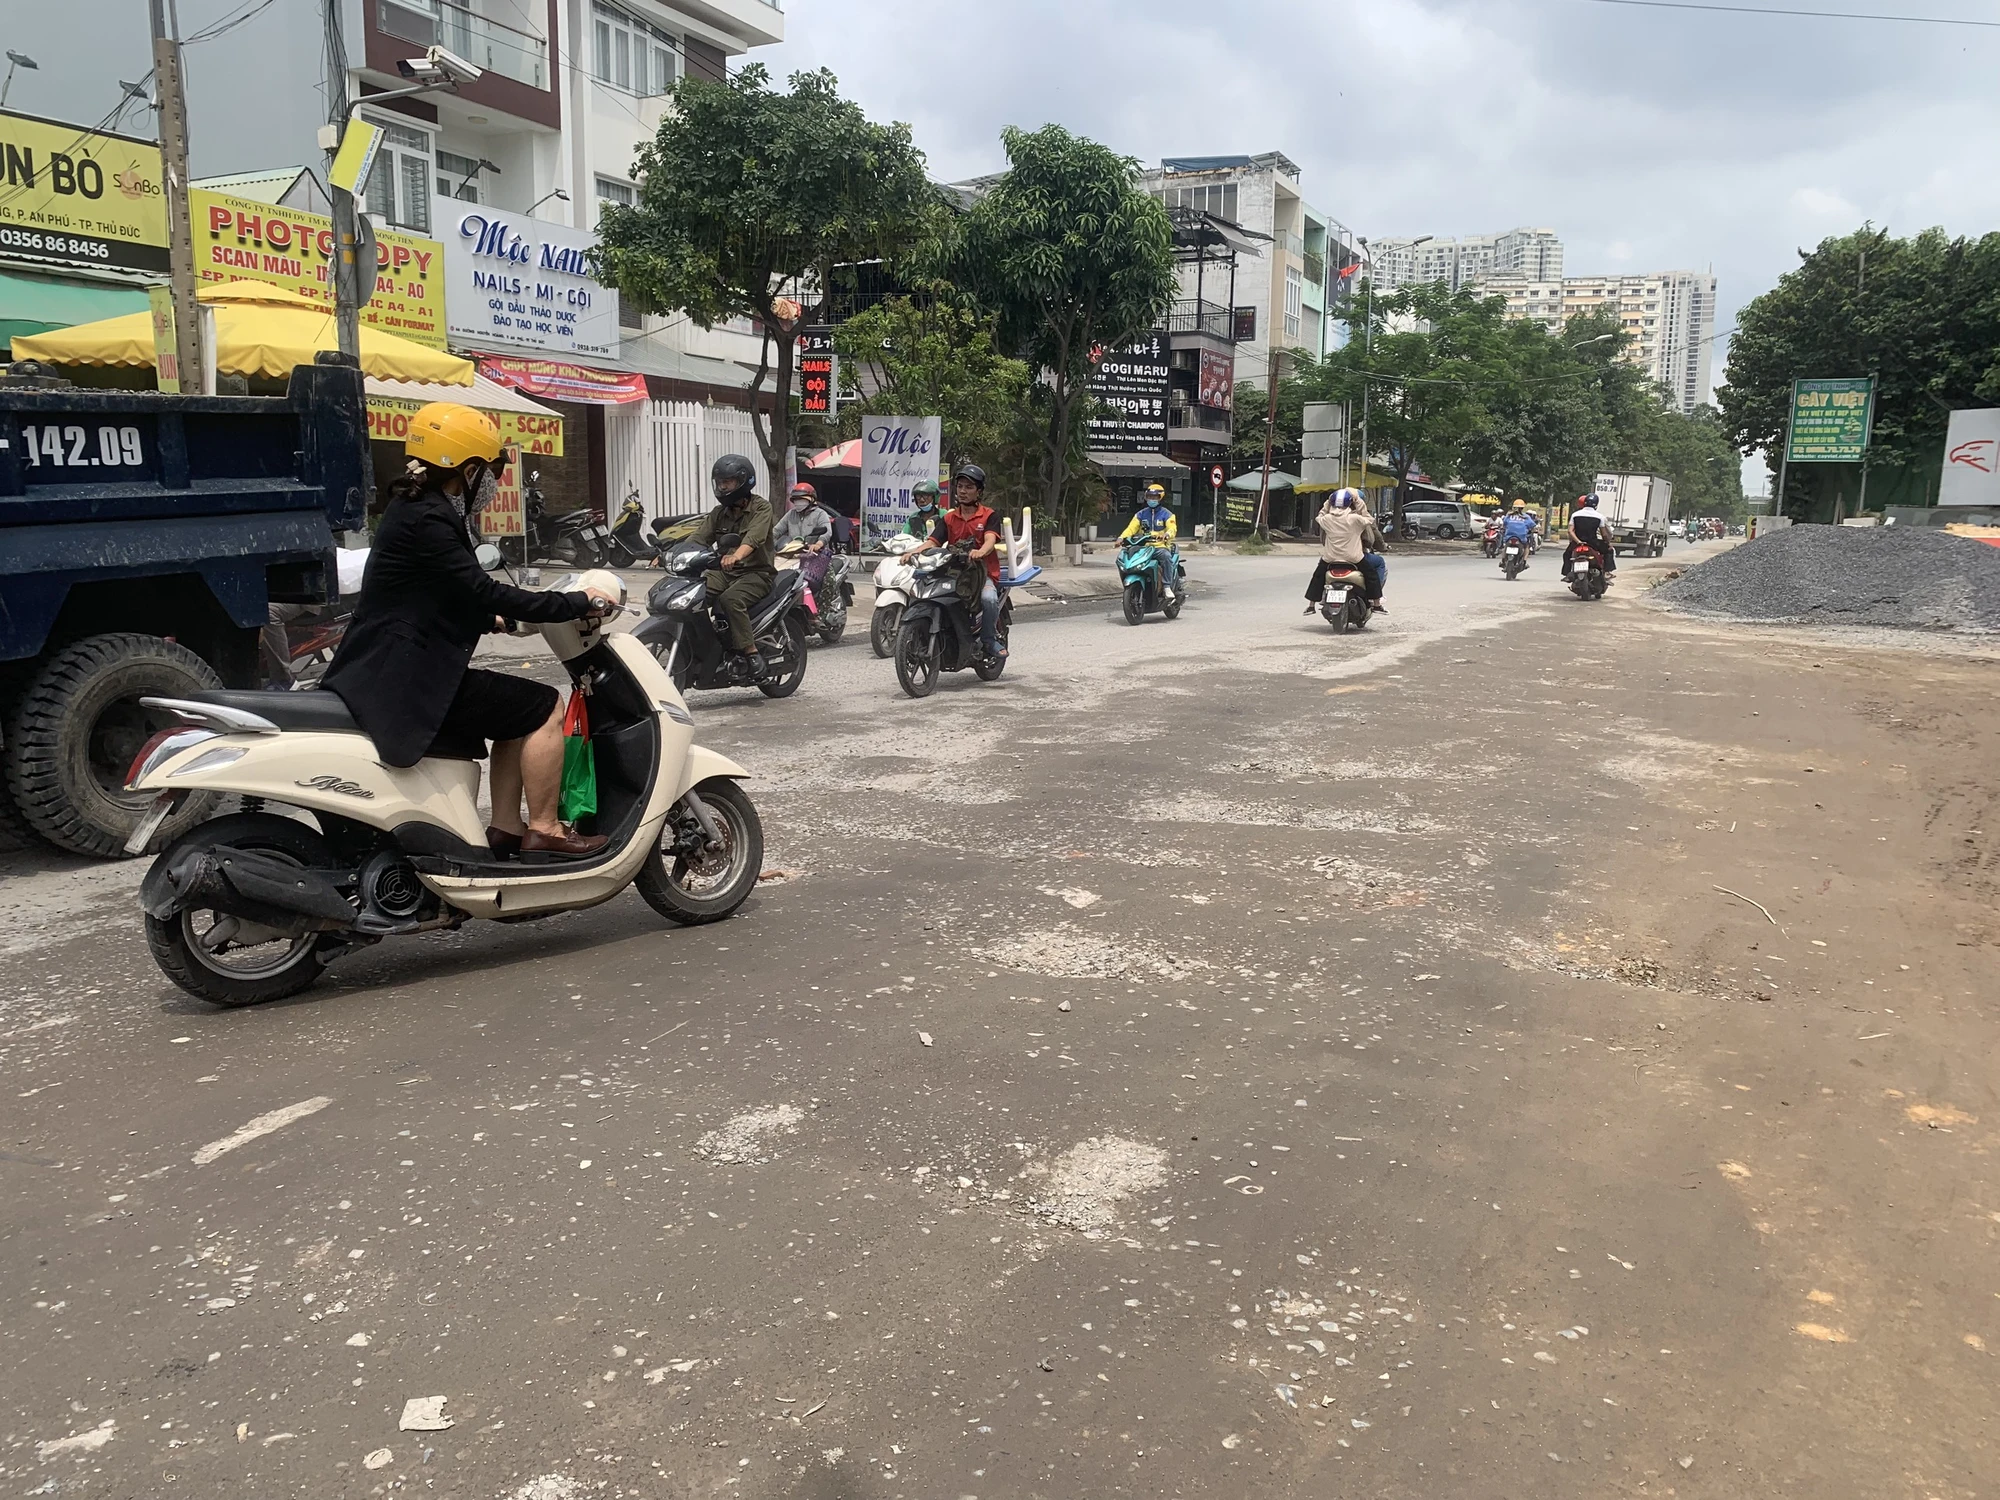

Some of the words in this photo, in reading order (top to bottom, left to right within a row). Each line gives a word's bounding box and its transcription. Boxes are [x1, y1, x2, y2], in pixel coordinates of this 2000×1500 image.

[51, 148, 104, 200] BÒ
[29, 212, 45, 224] AN
[47, 214, 70, 227] PHÚ
[96, 220, 117, 235] THỦ
[119, 224, 141, 238] ĐỨC
[253, 204, 264, 213] TY
[267, 208, 291, 219] TNHH
[307, 216, 320, 225] TM
[0, 229, 43, 249] 0356
[45, 236, 66, 252] 86
[68, 239, 109, 258] 8456
[460, 215, 530, 266] Mộc
[541, 243, 597, 276] NAIL
[202, 268, 224, 282] ÉP
[212, 245, 258, 270] SCAN
[263, 254, 301, 277] MÀU
[376, 276, 394, 294] A4
[407, 281, 424, 299] A0
[299, 285, 318, 298] ÉP
[387, 301, 405, 313] A4
[418, 306, 433, 317] A1
[473, 270, 521, 294] NAILS
[536, 283, 553, 300] MI
[567, 287, 591, 310] GỘI
[489, 298, 503, 315] GỘI
[493, 313, 512, 327] ĐÀO
[516, 318, 532, 330] TẠO
[536, 322, 552, 334] HỌC
[556, 324, 574, 337] VIÊN
[802, 360, 830, 372] NAILS
[1101, 362, 1132, 375] GOGI
[1133, 364, 1168, 377] MARU
[807, 377, 826, 393] GỘI
[1797, 391, 1830, 407] CÂY
[1832, 390, 1868, 409] VIỆT
[367, 410, 412, 437] PHO
[517, 415, 560, 437] SCAN
[1127, 421, 1165, 430] CHAMPONG
[22, 425, 144, 467] 142.09
[868, 426, 931, 458] Mộc
[867, 487, 892, 508] NAILS
[898, 488, 910, 509] MI
